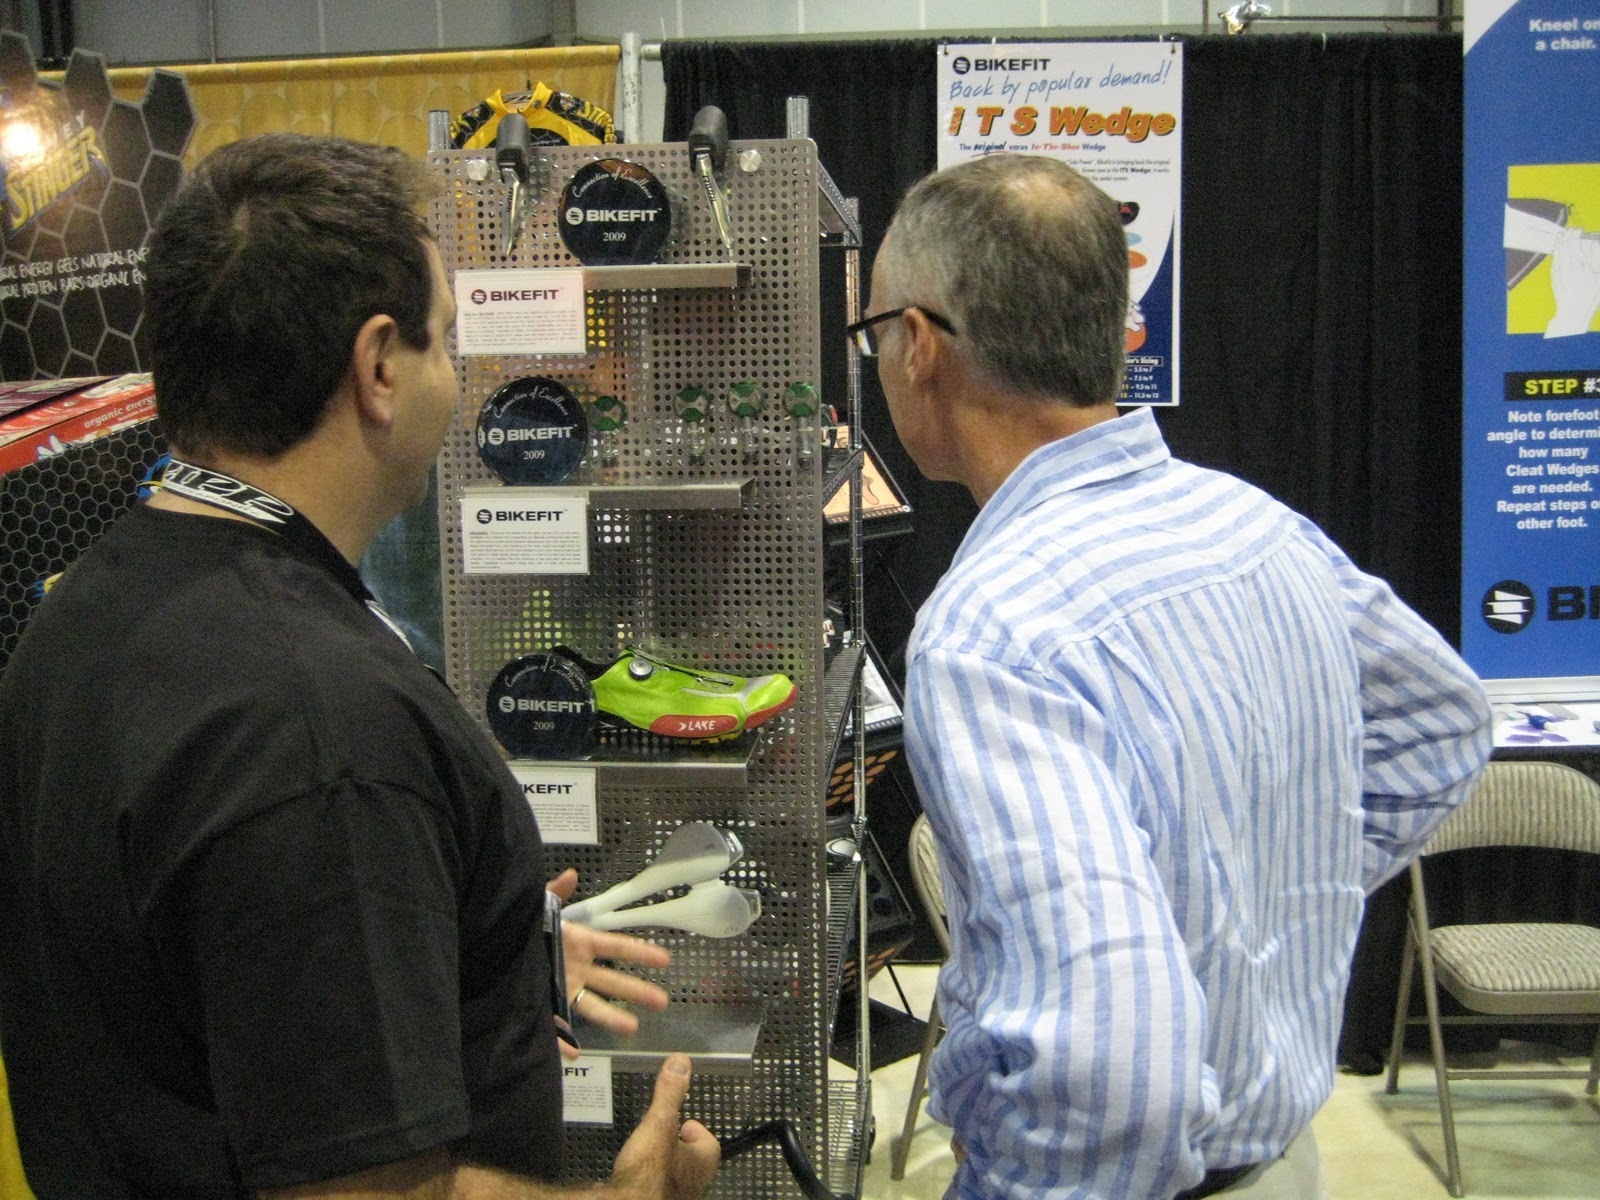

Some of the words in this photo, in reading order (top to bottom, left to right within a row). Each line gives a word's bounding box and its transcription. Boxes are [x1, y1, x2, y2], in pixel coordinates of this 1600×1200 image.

[1529, 19, 1579, 32] Kneel
[1535, 40, 1547, 51] a
[1551, 37, 1597, 51] chair.
[974, 58, 1051, 72] BIKEFIT
[950, 76, 993, 101] Back
[1000, 76, 1021, 104] by
[1025, 71, 1093, 105] popular
[1099, 60, 1172, 88] demand!
[1050, 106, 1177, 143] Wedge
[1082, 143, 1106, 153] Wedge
[586, 209, 658, 222] BIKEFIT
[603, 232, 627, 242] 2009
[490, 289, 559, 302] BIKEFIT
[1525, 379, 1578, 395] STEP
[84, 408, 124, 428] organic
[1508, 411, 1542, 423] Note
[1546, 408, 1600, 422] forefoot
[507, 427, 573, 442] BIKEFIT
[1487, 429, 1527, 444] angle
[1531, 429, 1545, 440] to
[1549, 426, 1600, 440] determi
[523, 450, 545, 460] 2009
[1518, 447, 1548, 458] how
[1552, 447, 1589, 460] many
[1506, 464, 1544, 477] Cleat
[1547, 463, 1600, 478] Wedges
[1512, 485, 1536, 494] are
[1539, 480, 1593, 494] needed.
[1497, 500, 1546, 515] Repeat
[1550, 500, 1586, 513] steps
[496, 511, 563, 522] BIKEFIT
[1516, 517, 1553, 529] other
[1557, 516, 1588, 529] foot.
[517, 698, 584, 714] BIKEFIT
[533, 721, 556, 731] 2009
[688, 720, 716, 731] LAKE
